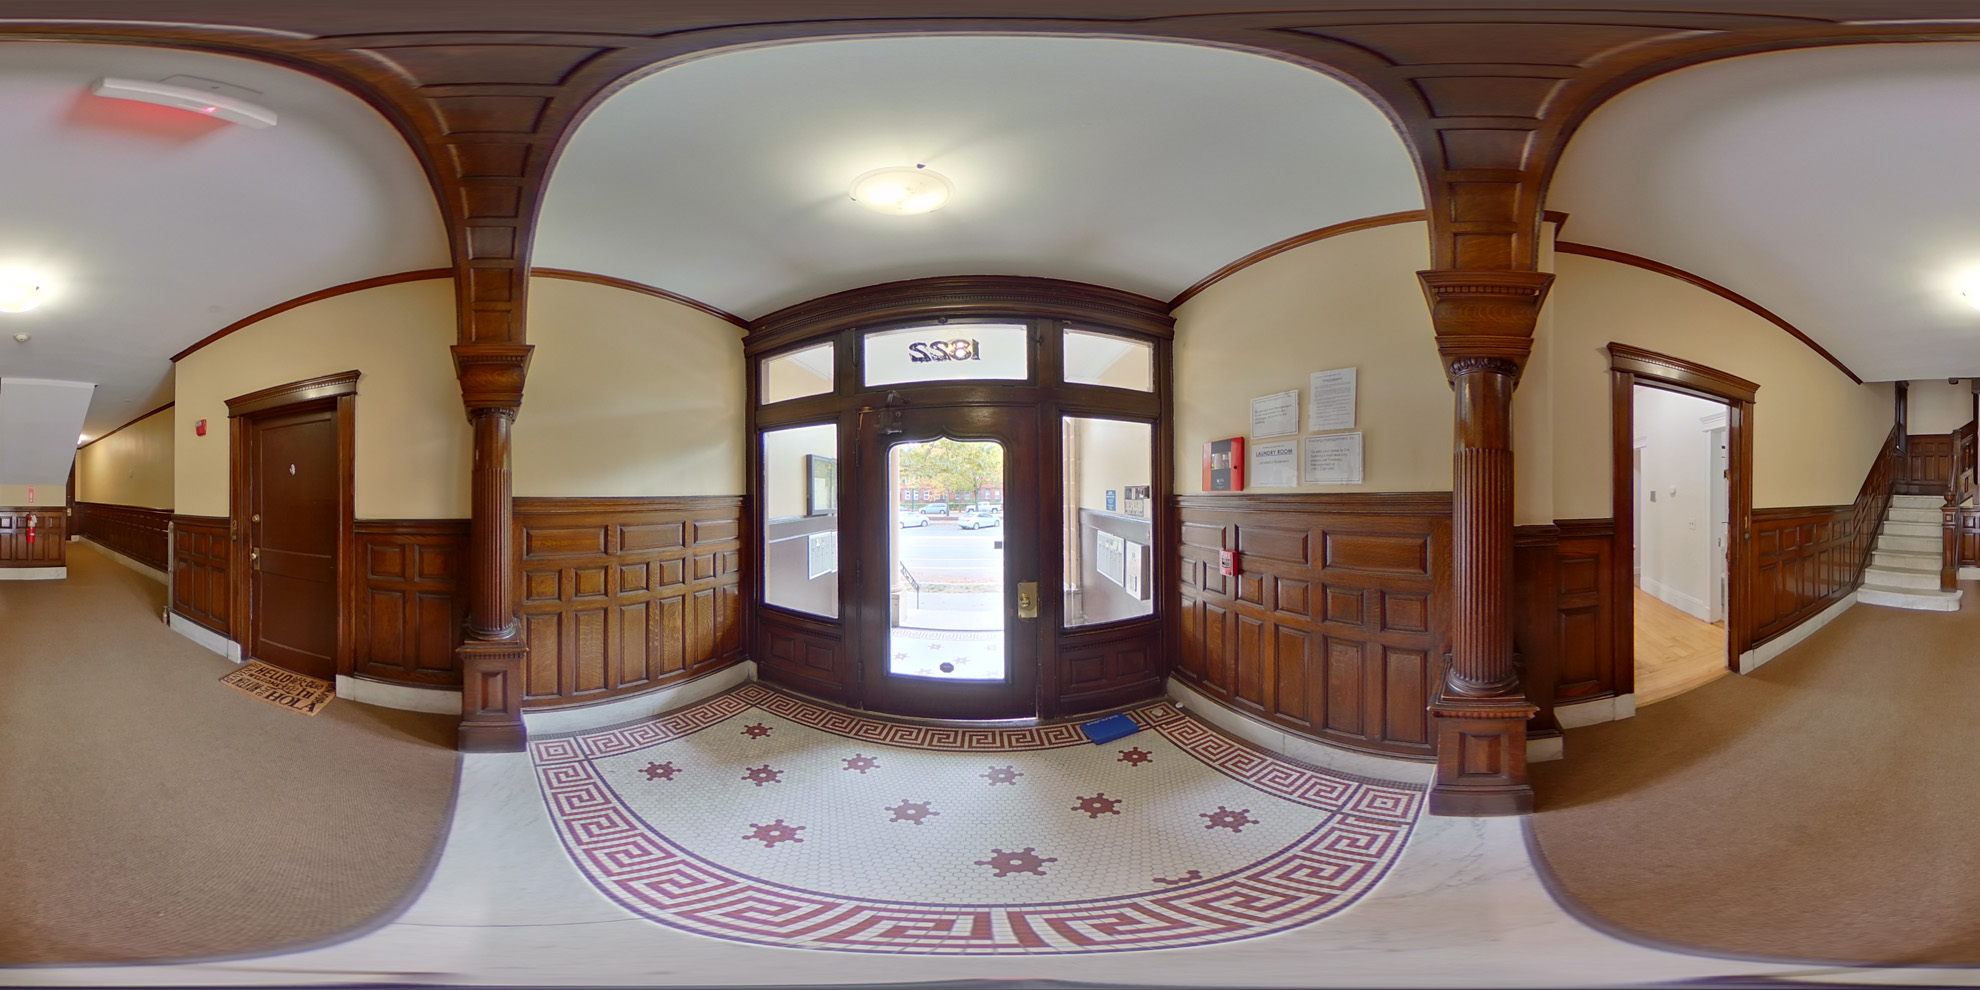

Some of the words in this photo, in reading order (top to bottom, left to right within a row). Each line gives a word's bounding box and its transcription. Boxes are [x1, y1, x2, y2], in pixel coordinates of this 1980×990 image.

[232, 519, 237, 530] 2
[247, 673, 281, 687] WELCOME
[254, 666, 292, 683] HELLO
[264, 691, 316, 713] HOLA
